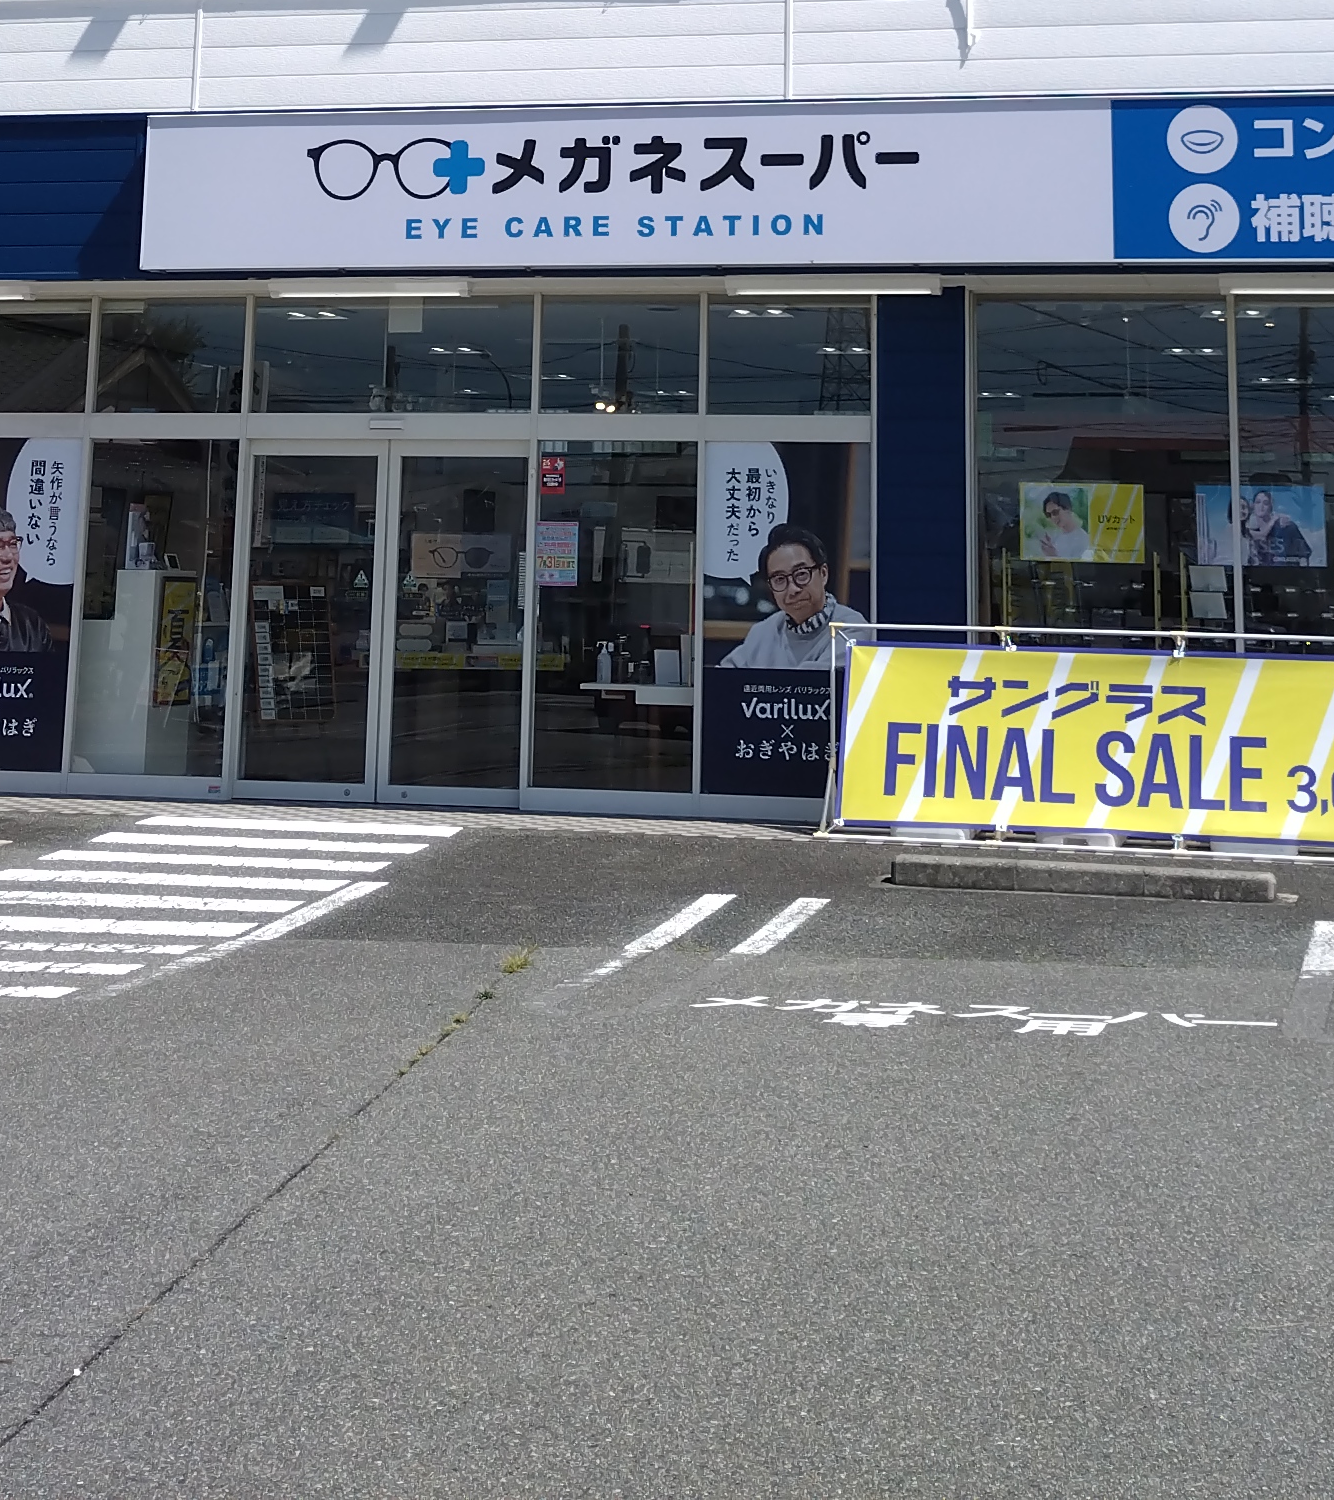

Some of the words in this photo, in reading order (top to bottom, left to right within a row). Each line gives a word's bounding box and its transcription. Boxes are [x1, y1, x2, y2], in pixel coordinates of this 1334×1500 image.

[492, 131, 919, 194] メガネスーパー
[405, 217, 479, 240] EYE
[504, 216, 611, 238] CARE
[636, 213, 824, 238] STATION
[25, 459, 46, 546] 間違いない
[45, 460, 65, 567] 矢作が言うなら
[725, 467, 742, 563] 大丈夫だった
[745, 467, 761, 537] 最初から
[765, 467, 778, 525] いきなり
[948, 675, 1206, 727] サングラス
[882, 721, 1075, 805] FINAL
[1095, 730, 1267, 813] SALE
